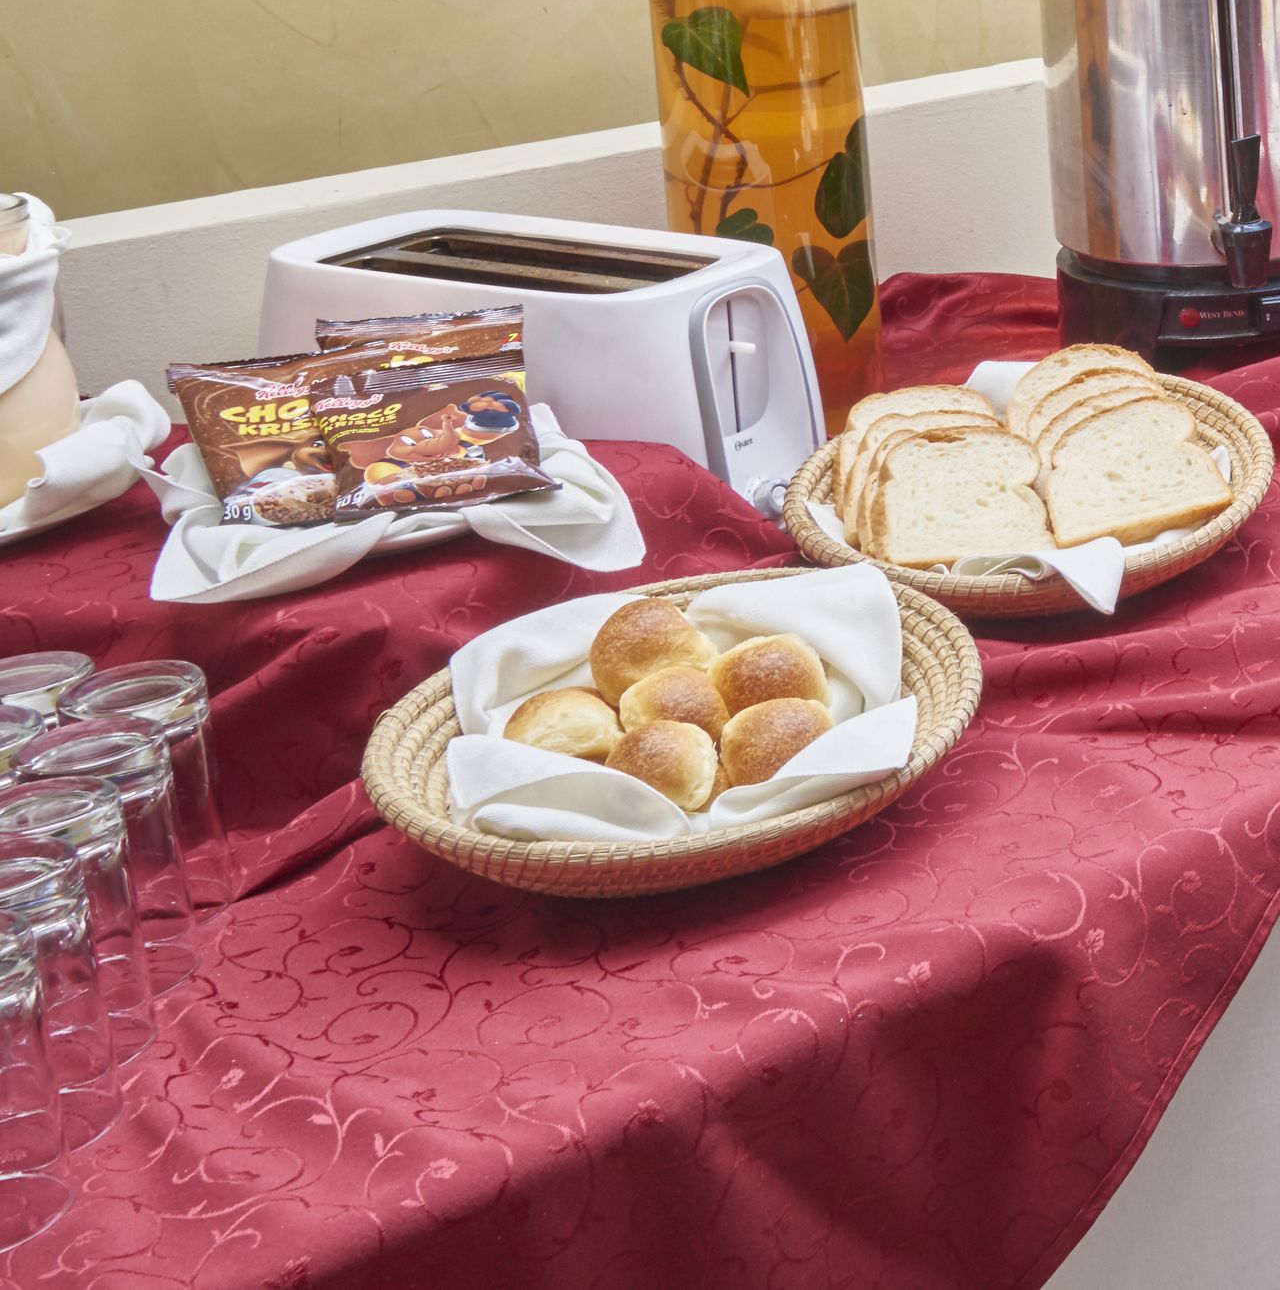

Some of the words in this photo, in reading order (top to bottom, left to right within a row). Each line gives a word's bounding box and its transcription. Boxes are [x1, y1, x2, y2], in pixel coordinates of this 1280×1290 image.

[1199, 311, 1222, 319] WEST
[1223, 310, 1244, 318] BEND
[219, 398, 310, 423] CHO
[319, 403, 402, 429] CHOCO
[324, 413, 397, 435] KRISPIS
[223, 504, 240, 520] 30
[242, 504, 252, 521] g
